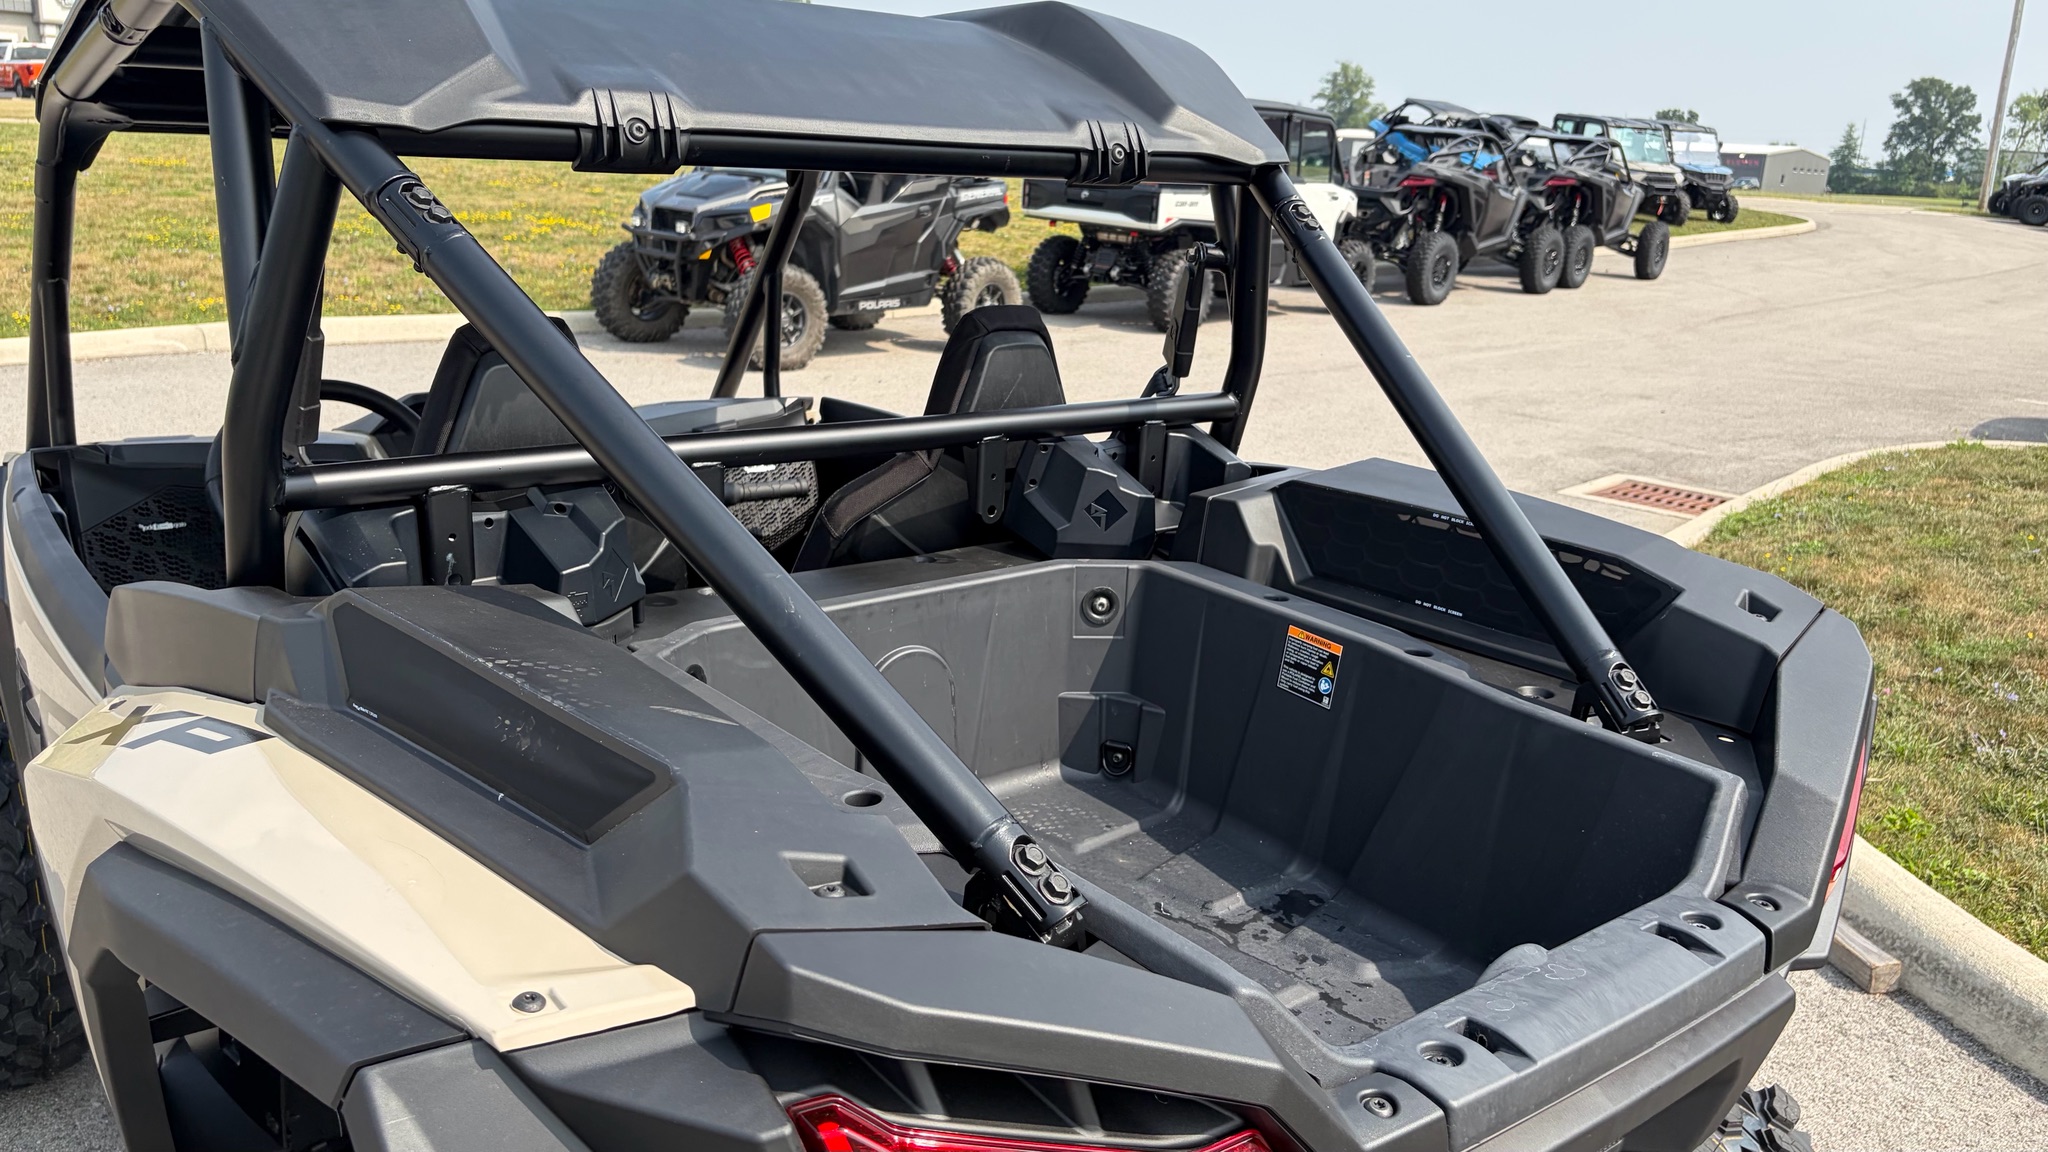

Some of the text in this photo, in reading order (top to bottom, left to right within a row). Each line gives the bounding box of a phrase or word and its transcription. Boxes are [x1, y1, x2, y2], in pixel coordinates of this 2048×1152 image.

[858, 299, 901, 311] POLARIS
[1432, 604, 1447, 612] BLOCK
[1447, 608, 1463, 617] SCREEN
[1304, 633, 1332, 650] WARNING
[62, 705, 277, 755] XP
